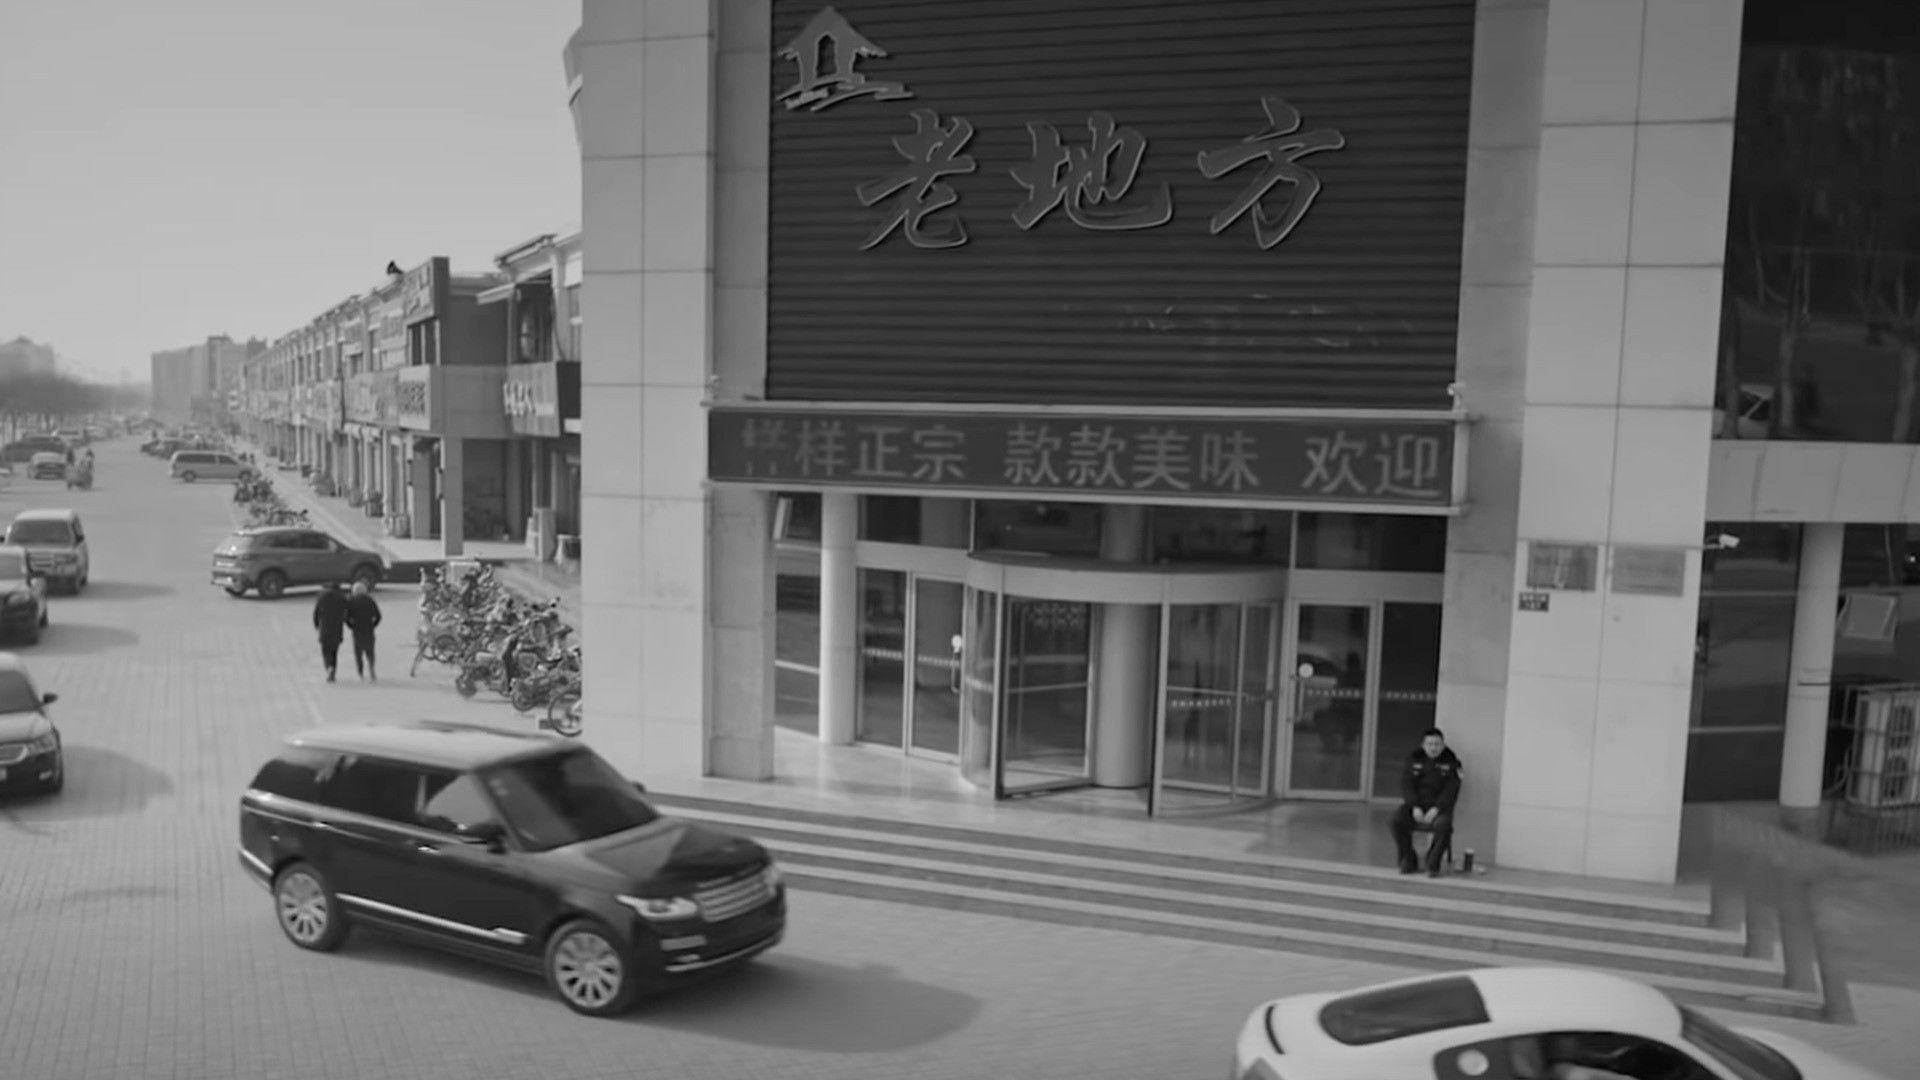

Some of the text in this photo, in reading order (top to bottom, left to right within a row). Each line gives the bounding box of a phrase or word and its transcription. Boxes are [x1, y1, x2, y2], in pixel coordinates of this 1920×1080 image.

[854, 96, 1346, 251] 老地方
[1003, 421, 1261, 492] 款款美味
[1300, 430, 1443, 498] 欢迎
